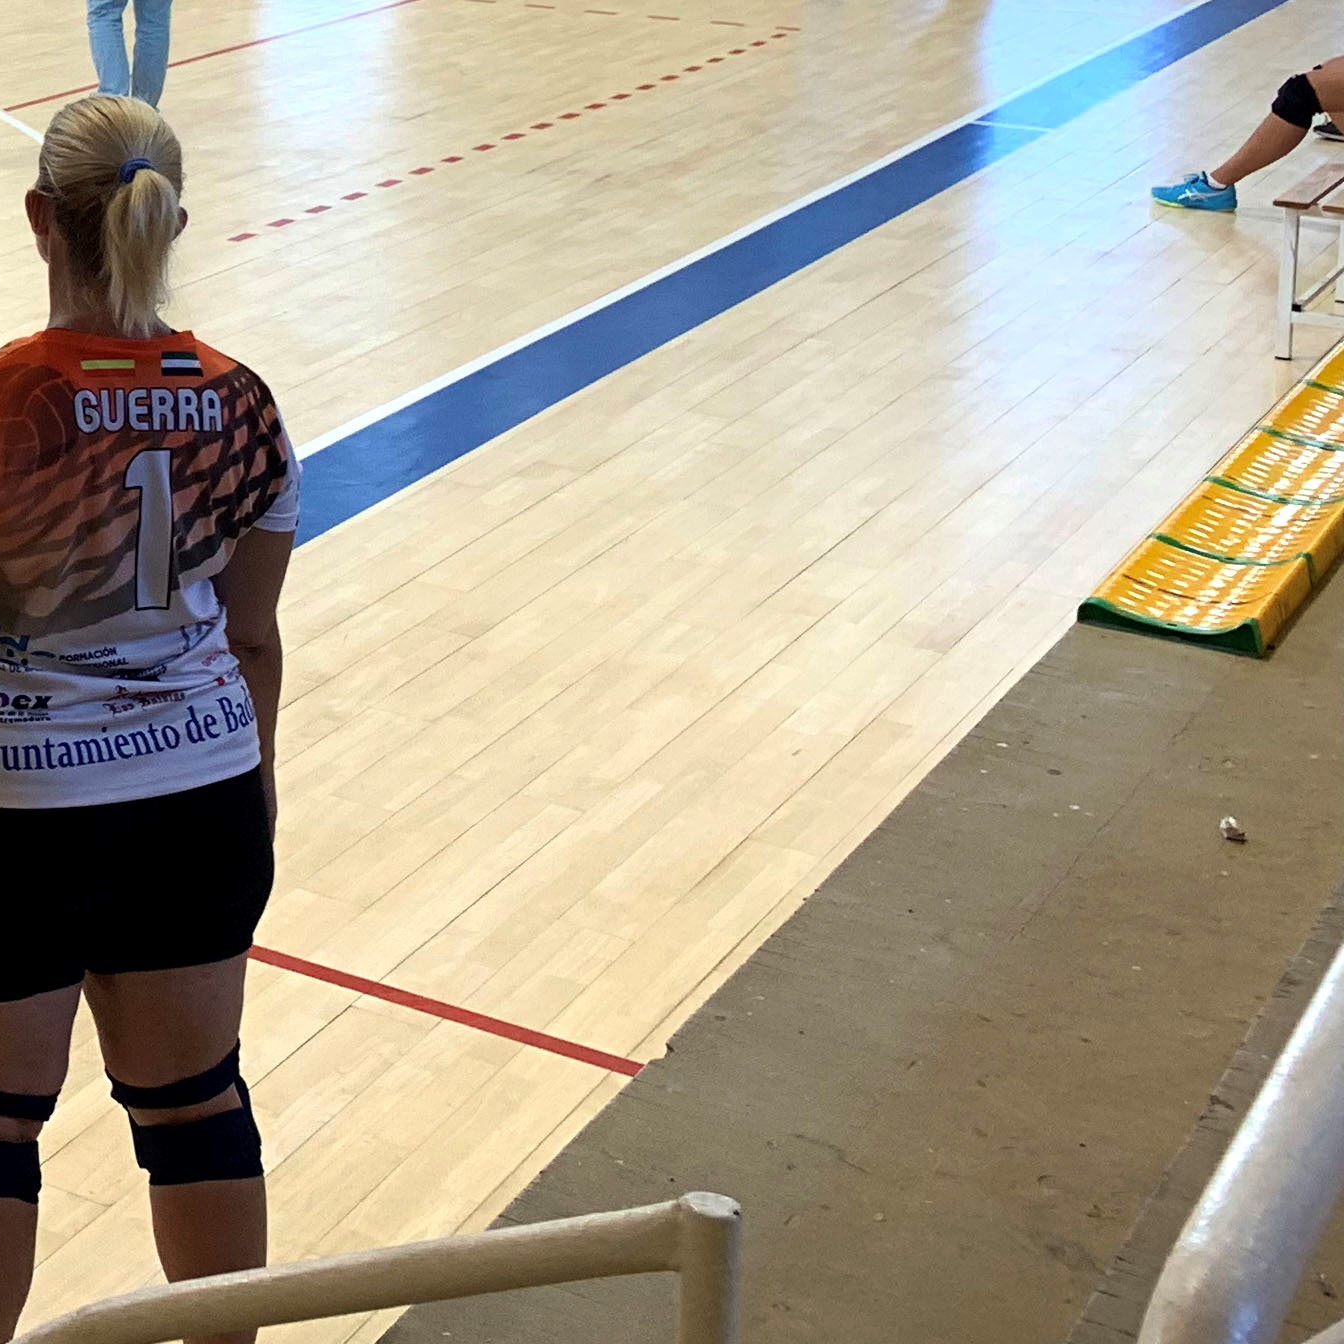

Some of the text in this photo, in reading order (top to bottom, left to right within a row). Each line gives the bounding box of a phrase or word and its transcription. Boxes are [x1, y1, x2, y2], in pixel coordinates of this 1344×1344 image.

[74, 388, 224, 434] GUERRA
[123, 449, 176, 611] 1
[186, 706, 221, 745] de
